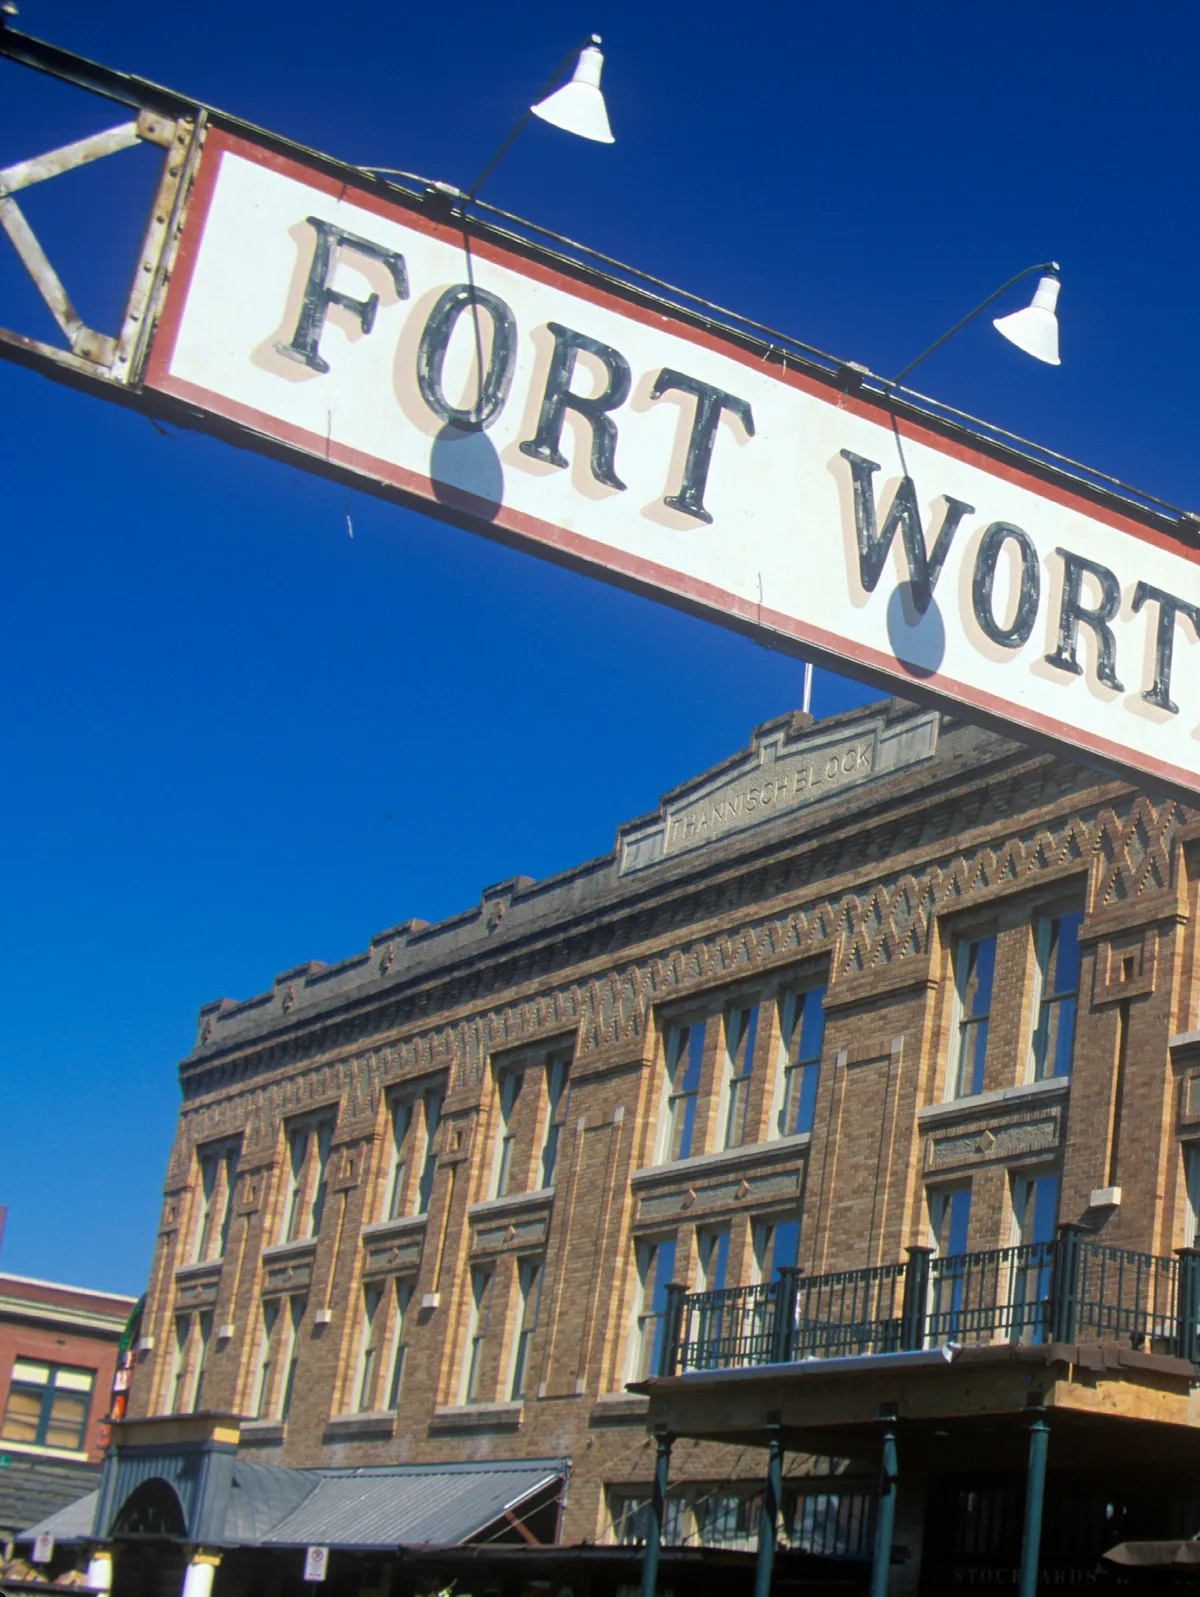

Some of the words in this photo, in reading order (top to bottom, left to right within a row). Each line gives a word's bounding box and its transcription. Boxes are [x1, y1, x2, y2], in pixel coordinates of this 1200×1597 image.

[271, 214, 756, 525] FORT
[671, 776, 787, 842] THANNISCH
[793, 742, 873, 794] BLOCK
[953, 1567, 1098, 1587] STOCKARDS
